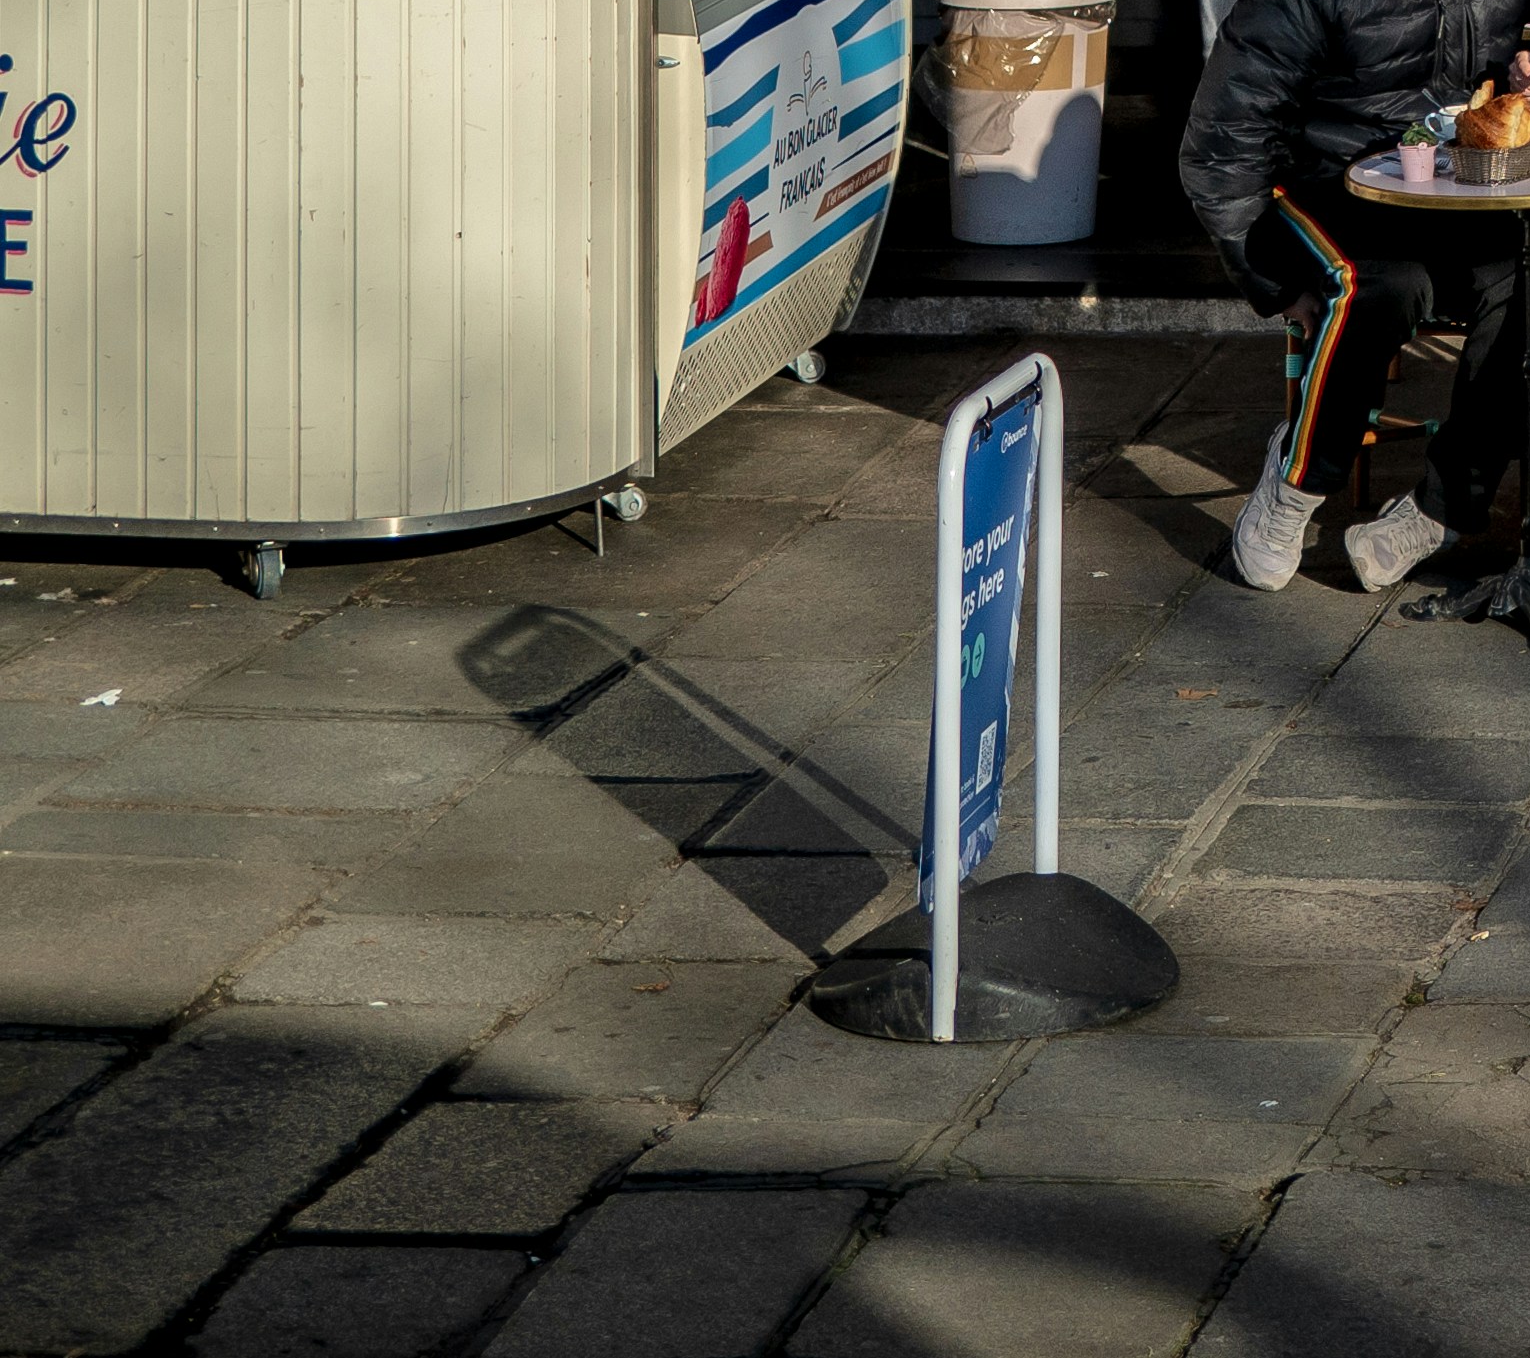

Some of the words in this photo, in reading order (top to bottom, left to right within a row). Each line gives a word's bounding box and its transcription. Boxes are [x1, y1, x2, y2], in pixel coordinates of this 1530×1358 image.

[773, 137, 787, 169] AU
[787, 125, 806, 160] BON
[807, 106, 838, 148] GLACIER
[779, 156, 825, 213] FRANÇAIS
[986, 514, 1015, 567] your
[961, 589, 976, 631] gs
[978, 567, 1004, 609] here
